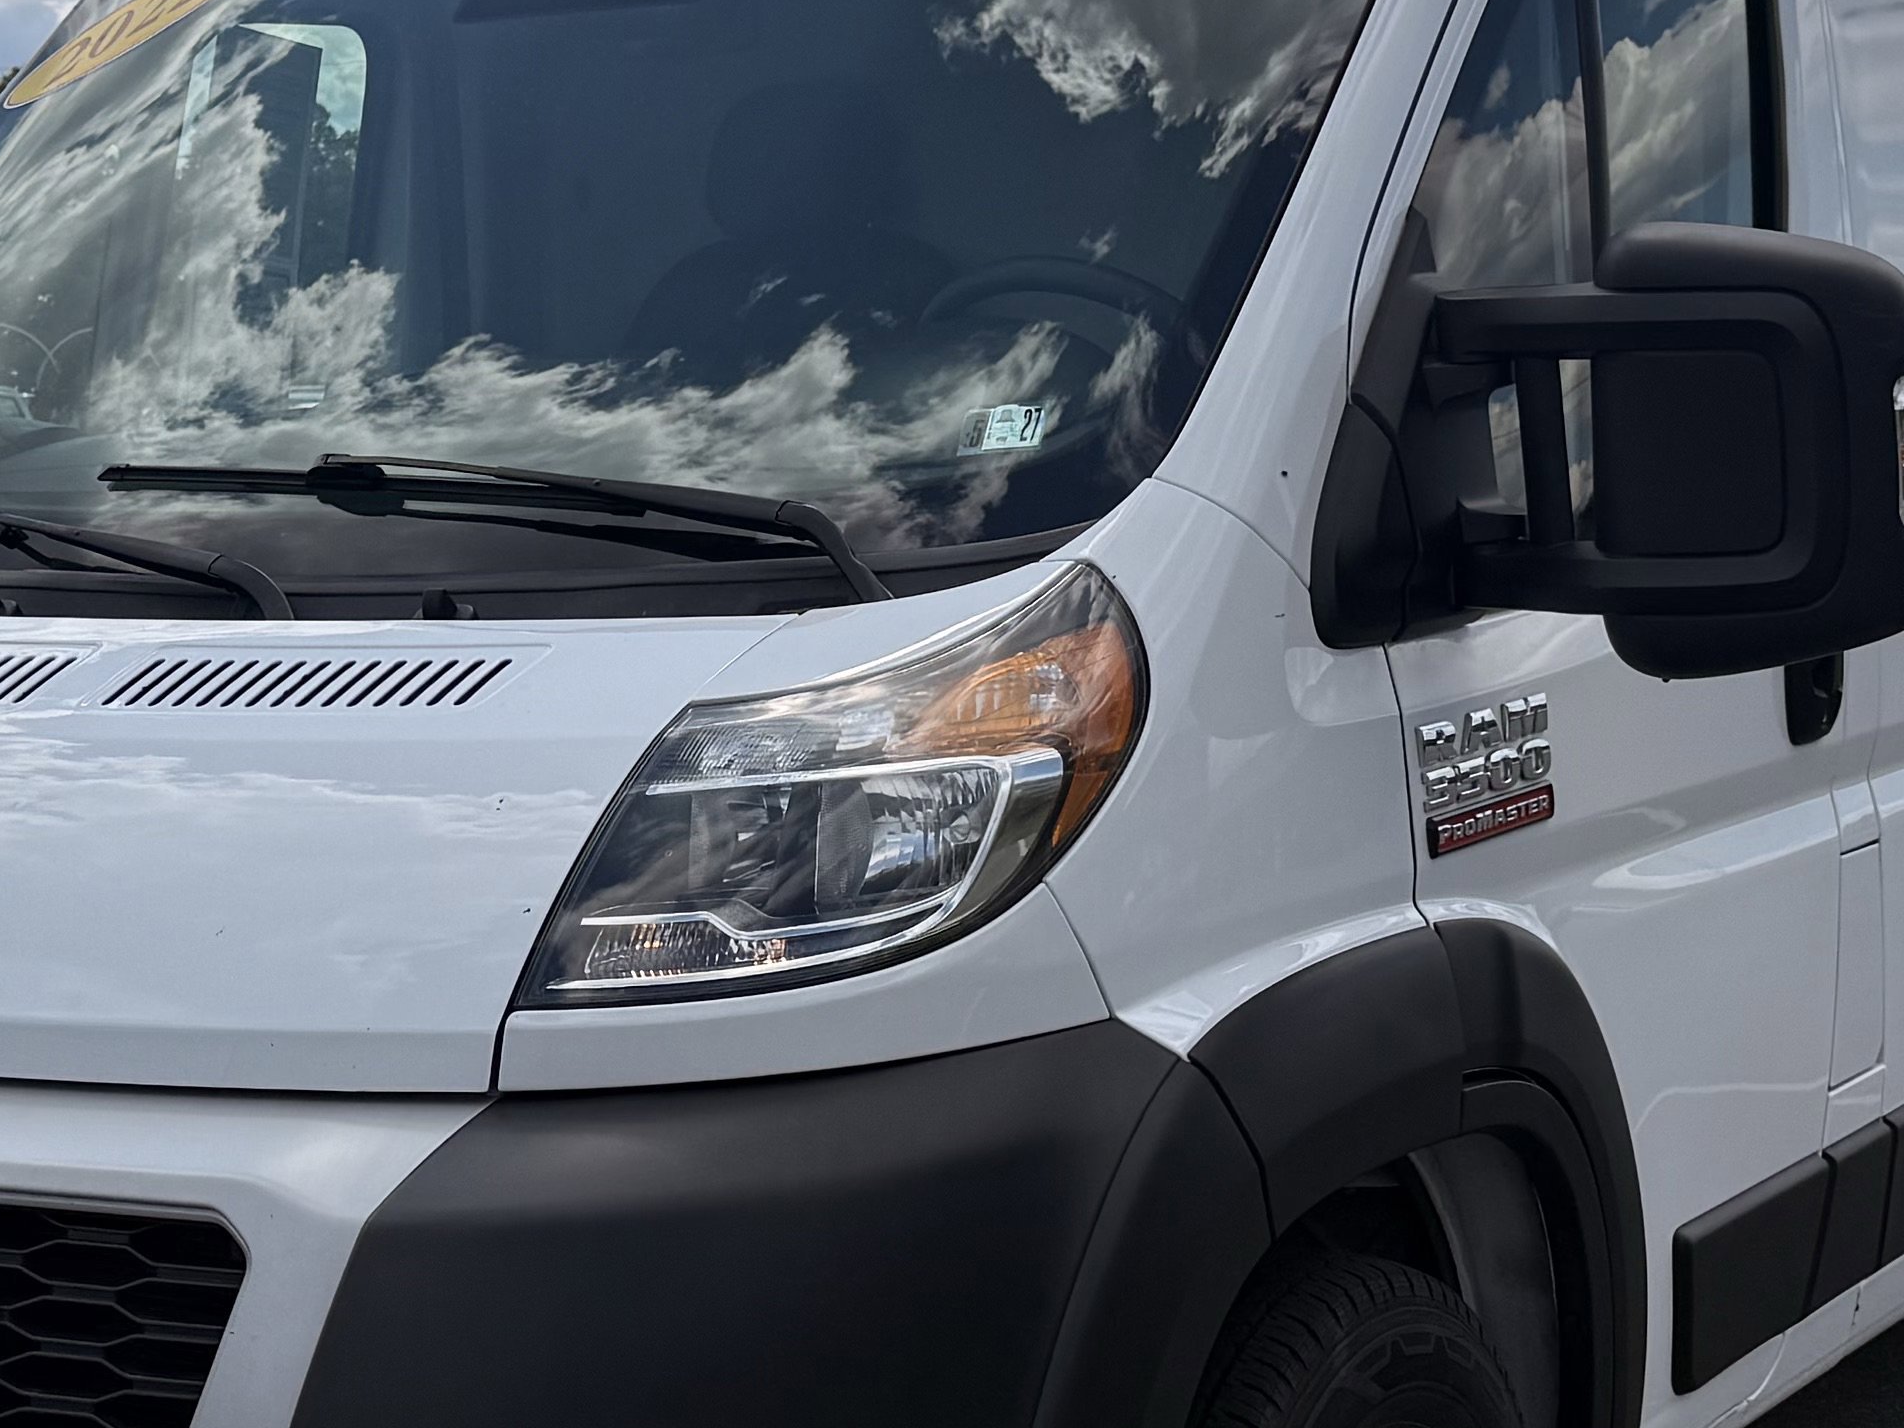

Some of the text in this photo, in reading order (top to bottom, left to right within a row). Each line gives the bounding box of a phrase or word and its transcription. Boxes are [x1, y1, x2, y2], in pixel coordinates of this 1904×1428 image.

[1019, 407, 1043, 443] 27
[1416, 692, 1549, 768] RAM
[1422, 738, 1552, 813] 3500
